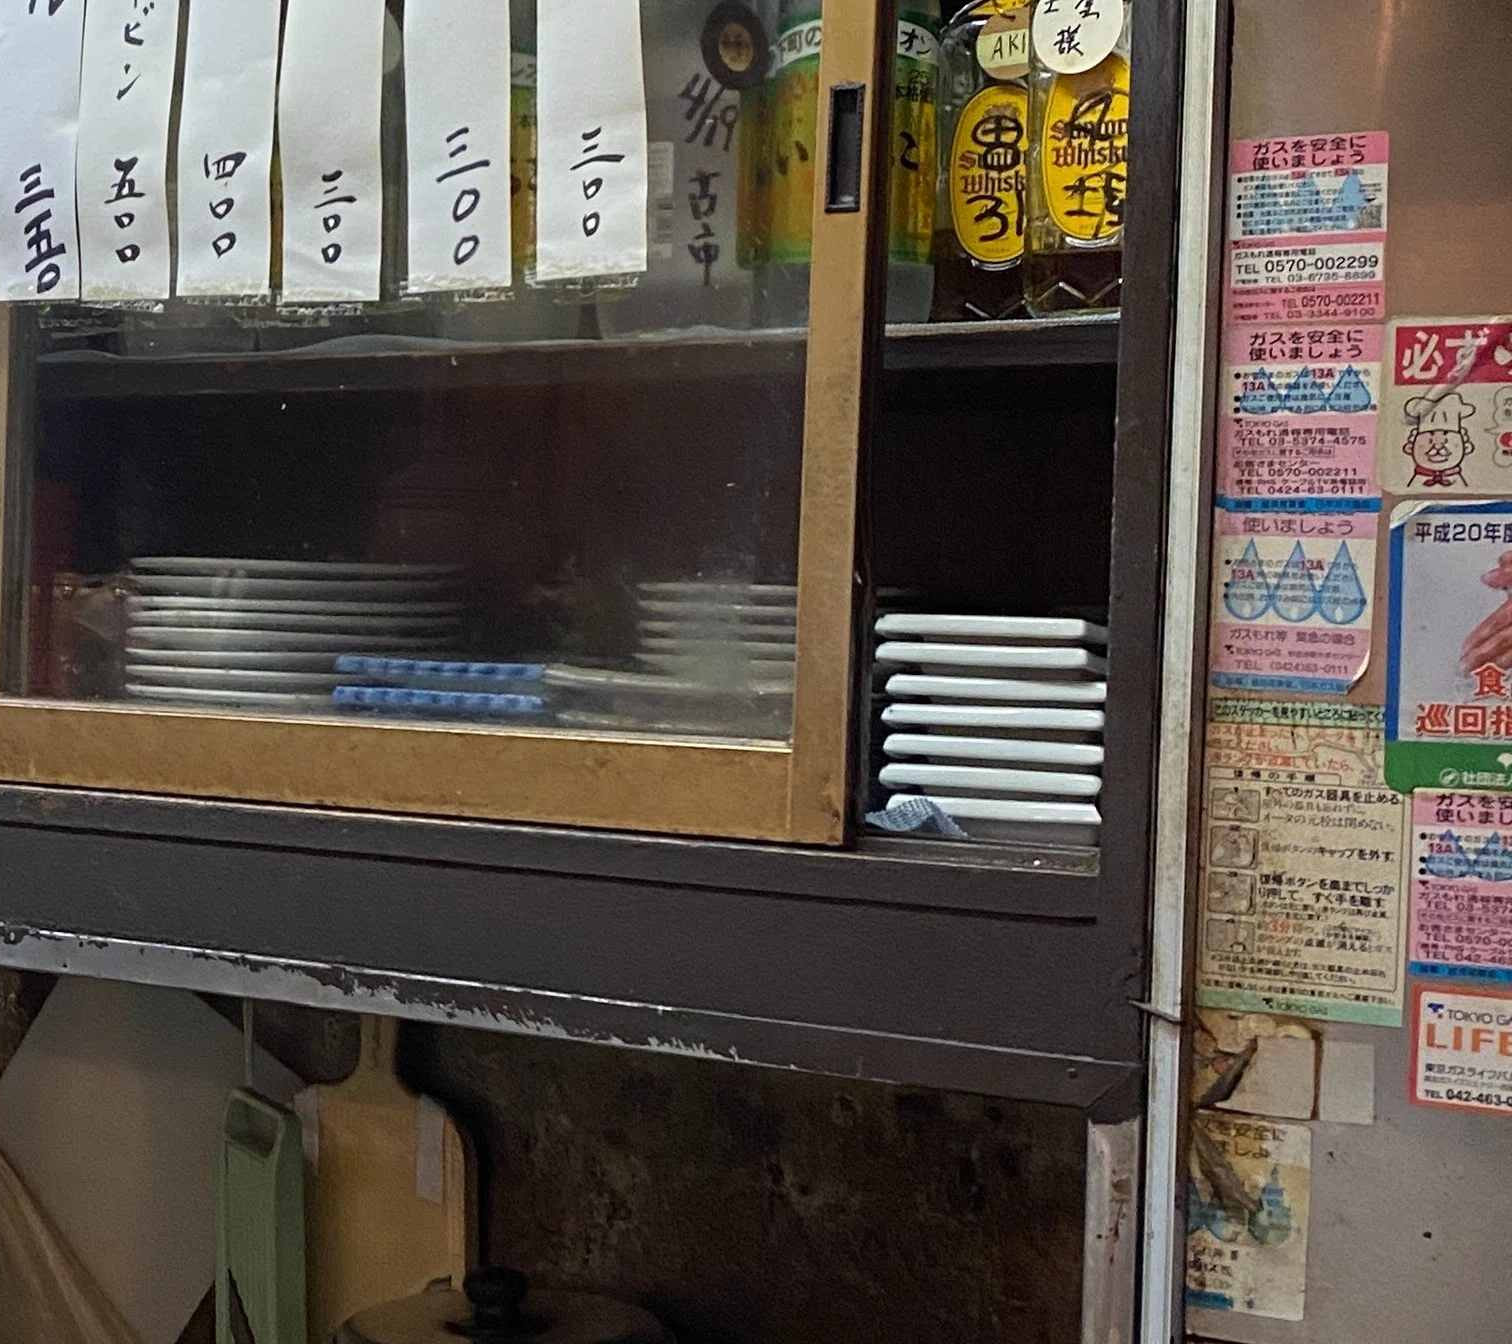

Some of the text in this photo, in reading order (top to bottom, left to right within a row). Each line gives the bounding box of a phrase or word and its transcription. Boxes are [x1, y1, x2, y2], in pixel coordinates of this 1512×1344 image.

[1253, 135, 1367, 155] ガスを安全に
[1253, 150, 1365, 170] 使いましょう
[1236, 255, 1379, 275] TEL 0570-002299
[1302, 293, 1380, 308] 0570-002211
[1250, 330, 1364, 346] ガスを安全に
[1249, 344, 1363, 362] 使いましょう
[1240, 437, 1264, 446] TEL
[1240, 468, 1264, 477] TEL
[1240, 486, 1264, 495] TEL
[1243, 517, 1356, 535] 使いましょう
[1473, 663, 1512, 699] 食
[1448, 1009, 1493, 1025] TOKYO
[1424, 1089, 1443, 1100] TEL
